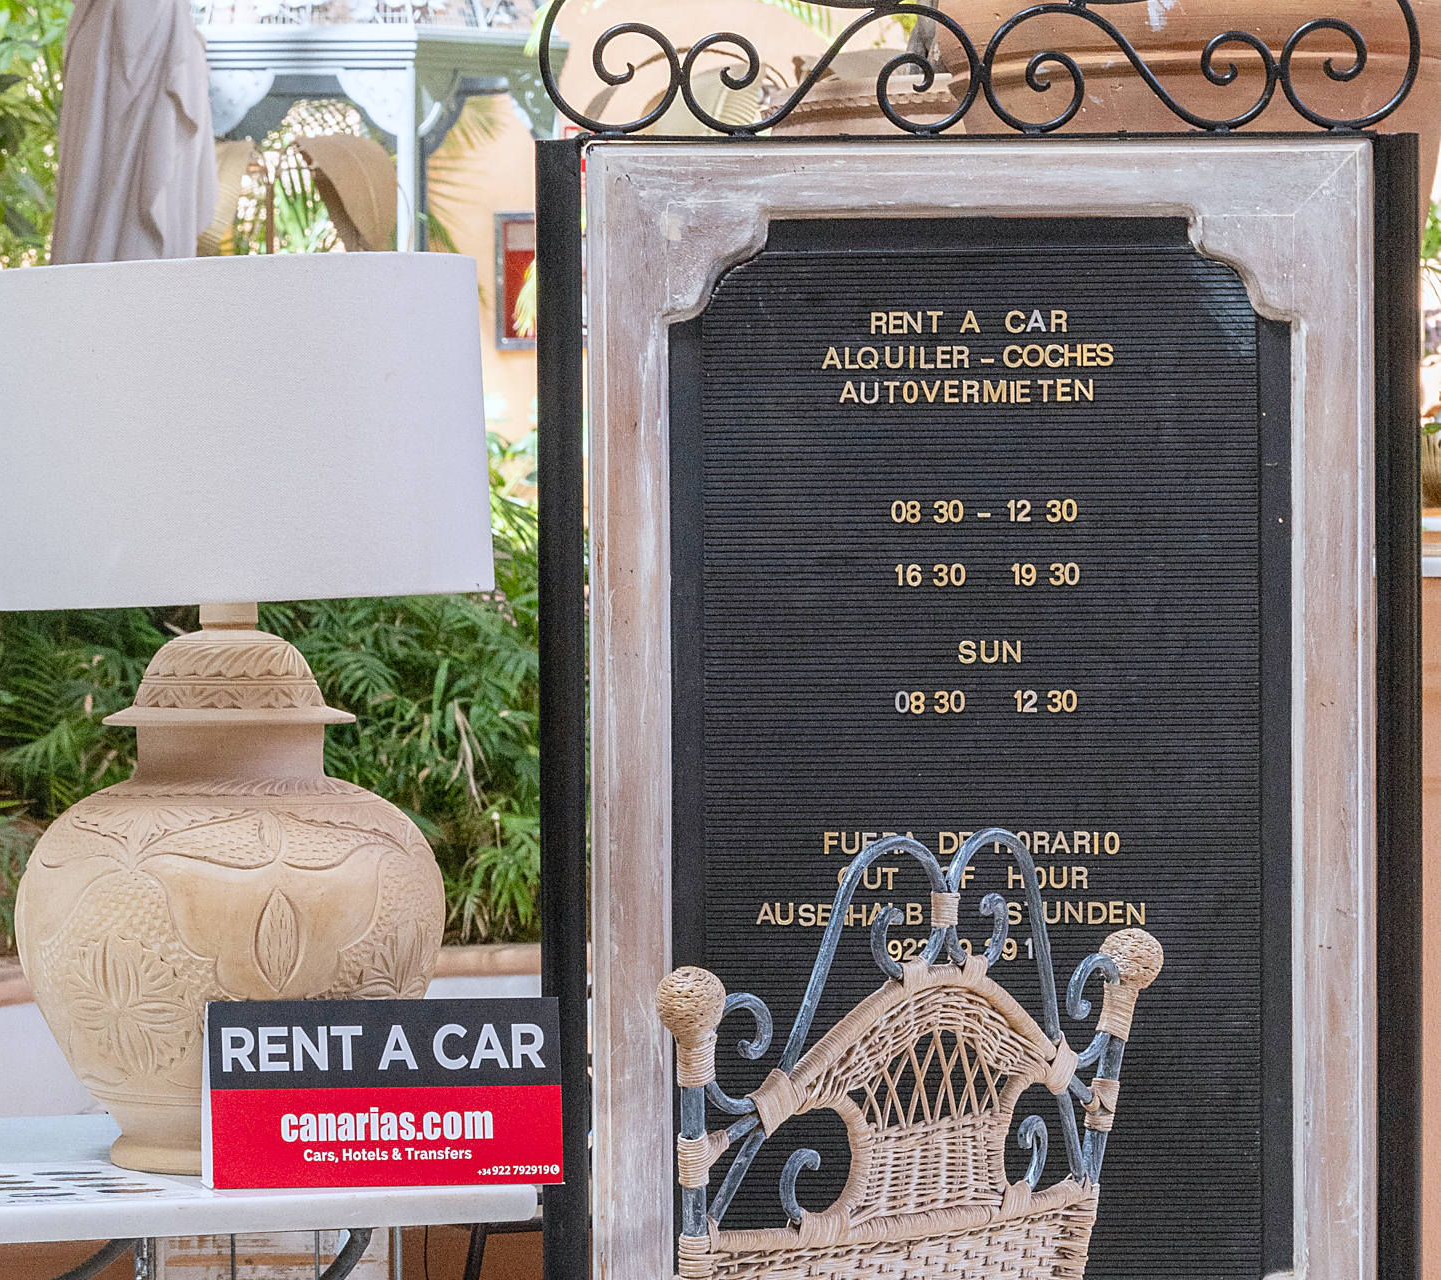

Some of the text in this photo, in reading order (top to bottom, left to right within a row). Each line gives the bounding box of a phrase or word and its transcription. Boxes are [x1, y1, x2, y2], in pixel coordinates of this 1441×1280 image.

[870, 309, 1069, 335] RENT A CAR
[821, 345, 970, 370] ALQUILER
[1002, 343, 1115, 368] COCHES
[890, 500, 922, 523] 08
[933, 499, 964, 523] 30
[1007, 499, 1032, 522] 12
[1046, 498, 1078, 523] 30
[894, 562, 1081, 587] 16 30 19 30
[958, 640, 1022, 664] SUN
[894, 689, 1078, 714] 08 30 12 30
[941, 866, 976, 889] F
[756, 901, 1146, 927] AUSEHAB SUNDEN
[220, 1022, 546, 1073] RENT A CAR
[280, 1107, 494, 1143] canarias.com
[303, 1146, 473, 1163] Cars, Hotels & Transfers
[492, 1165, 511, 1176] 922
[512, 1164, 550, 1175] 792919
